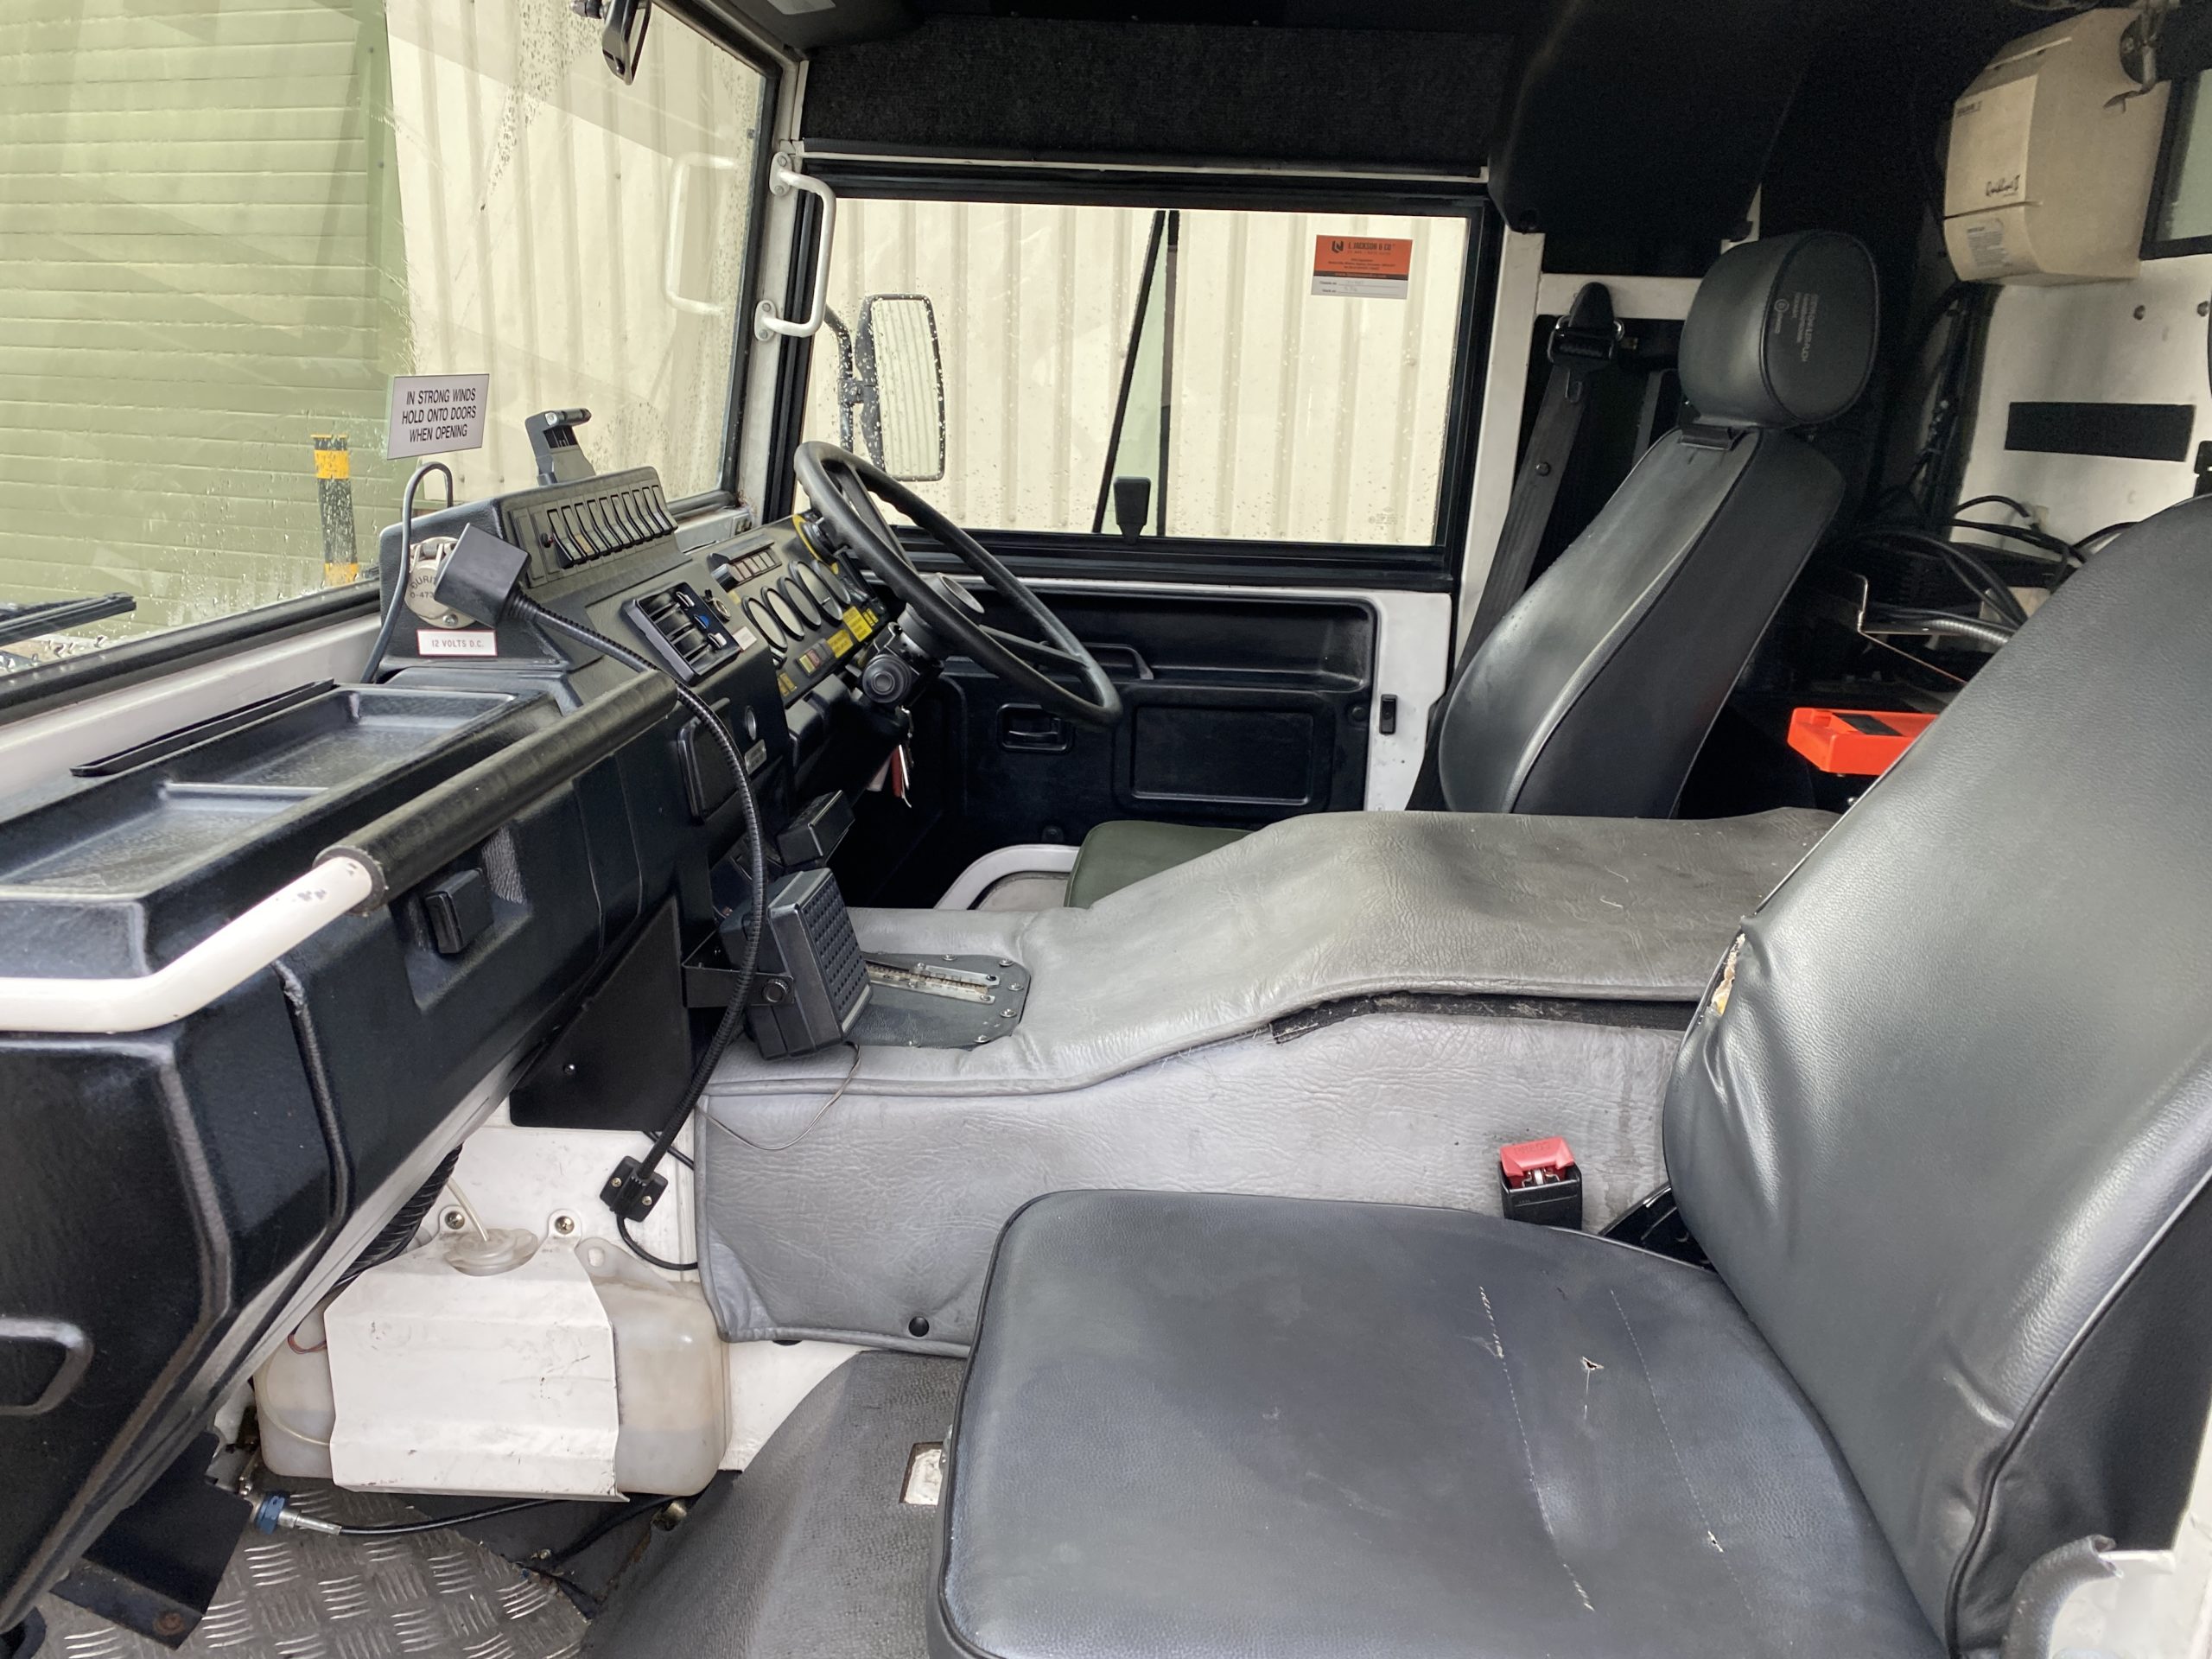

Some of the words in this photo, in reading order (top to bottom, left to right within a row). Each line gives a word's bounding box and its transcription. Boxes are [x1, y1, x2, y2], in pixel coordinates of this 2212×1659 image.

[406, 391, 415, 405] IN
[418, 390, 450, 404] STRONG
[453, 388, 476, 402] WINDS
[402, 410, 424, 425] HOLD
[427, 408, 448, 423] ONTO
[450, 405, 476, 420] DOORS
[410, 428, 432, 442] WHEN
[435, 424, 467, 440] OPENING
[410, 575, 435, 589] DURI
